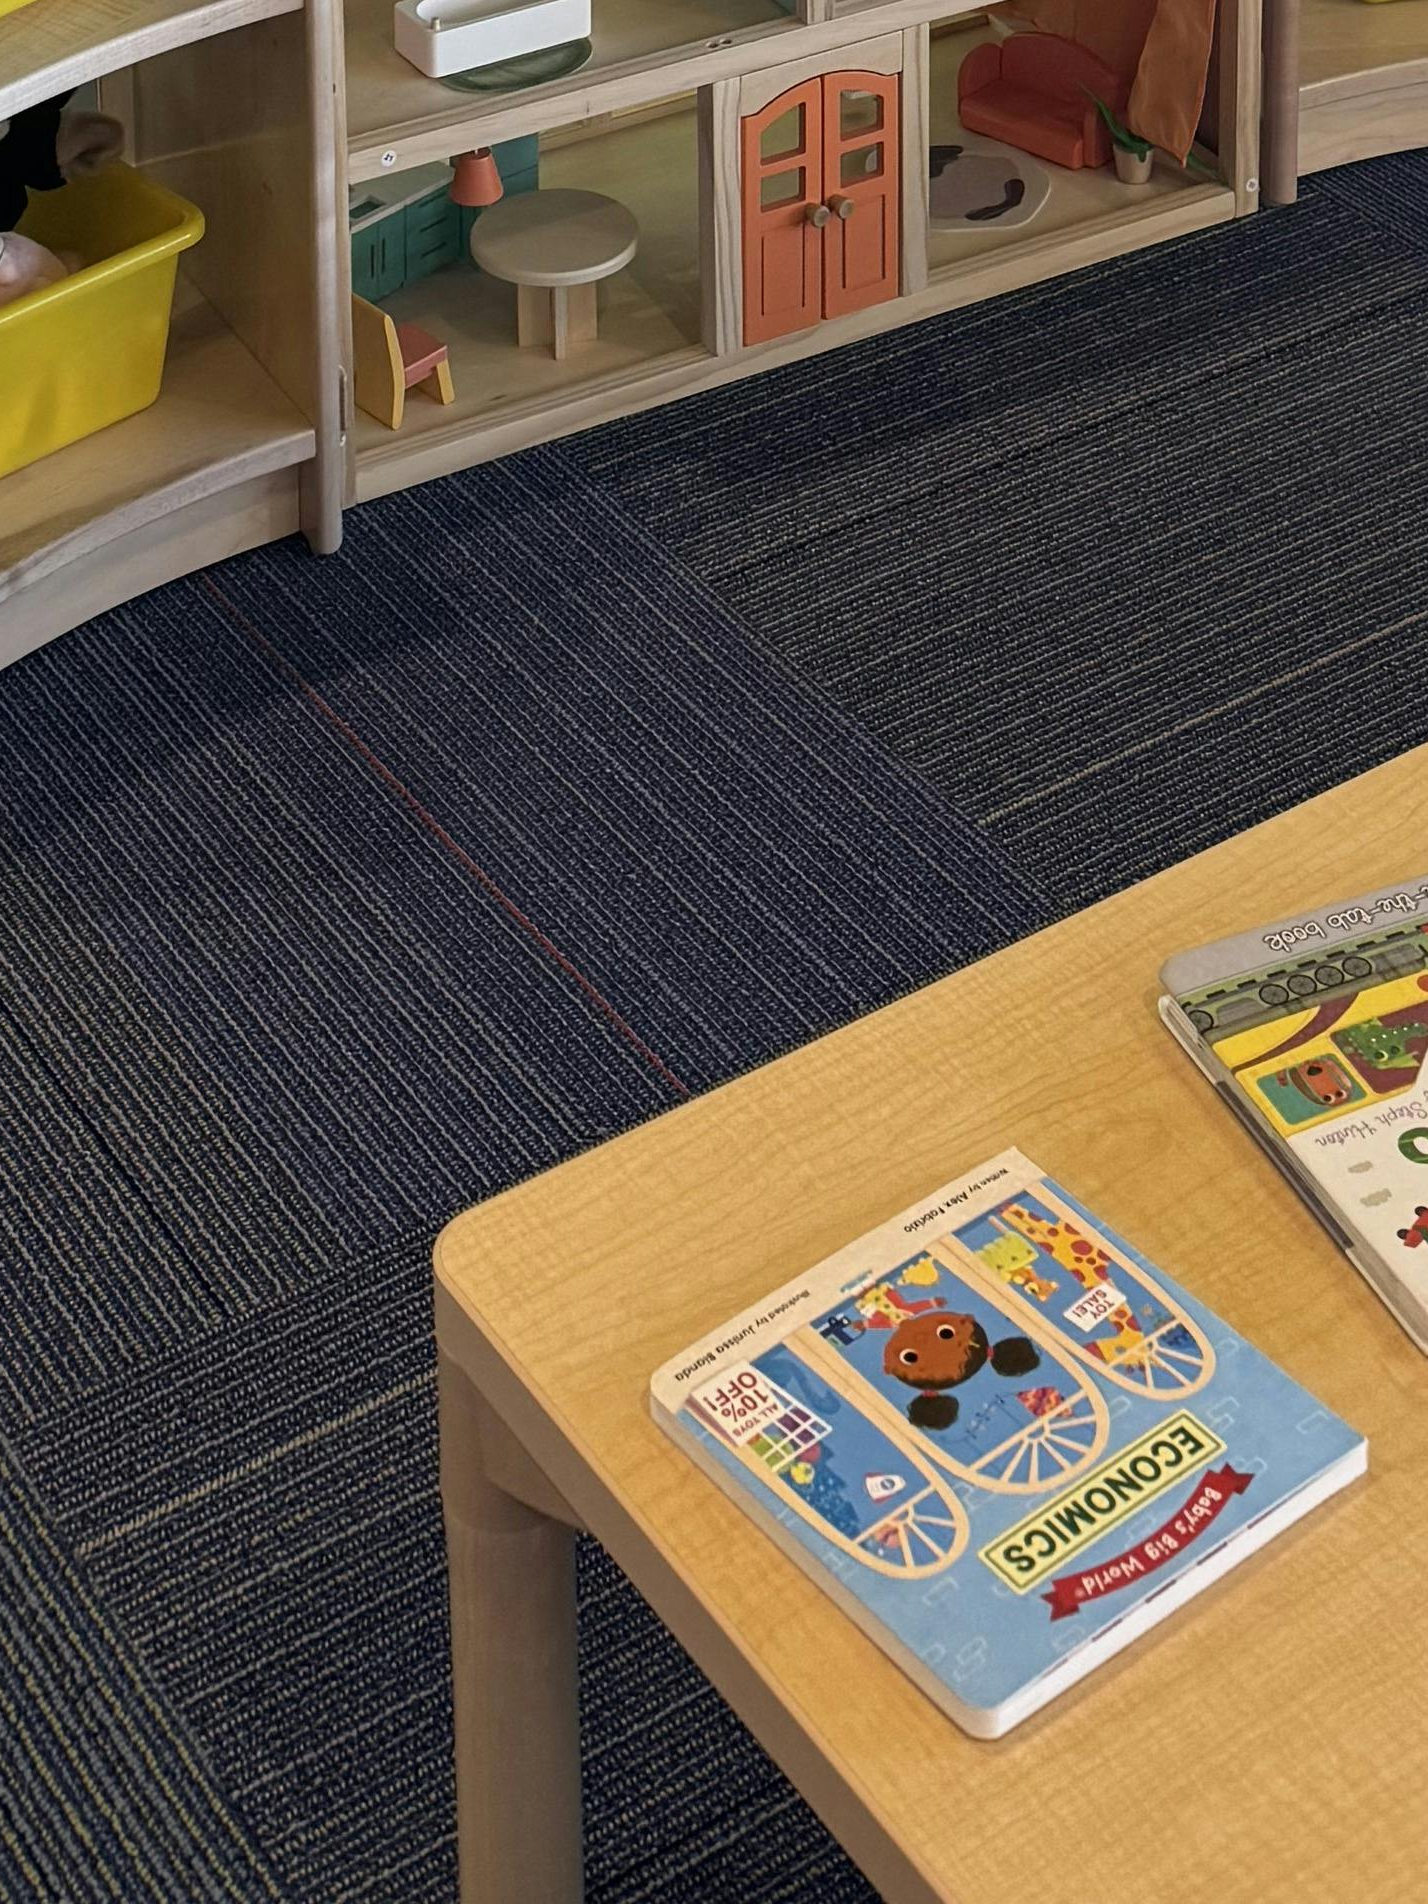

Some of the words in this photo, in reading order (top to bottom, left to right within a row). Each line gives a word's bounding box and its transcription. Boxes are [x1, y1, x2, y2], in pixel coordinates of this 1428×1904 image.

[1263, 921, 1327, 953] book
[1375, 1103, 1428, 1126] Steph
[1314, 1122, 1378, 1147] Hinton
[1072, 1290, 1108, 1318] SALE!
[1092, 1299, 1115, 1320] TOY
[702, 1371, 758, 1411] OFF!
[722, 1389, 769, 1423] 10%
[1002, 1426, 1205, 1573] ECONOMICS
[1179, 1486, 1223, 1536] Baby's
[1144, 1532, 1178, 1560] Big
